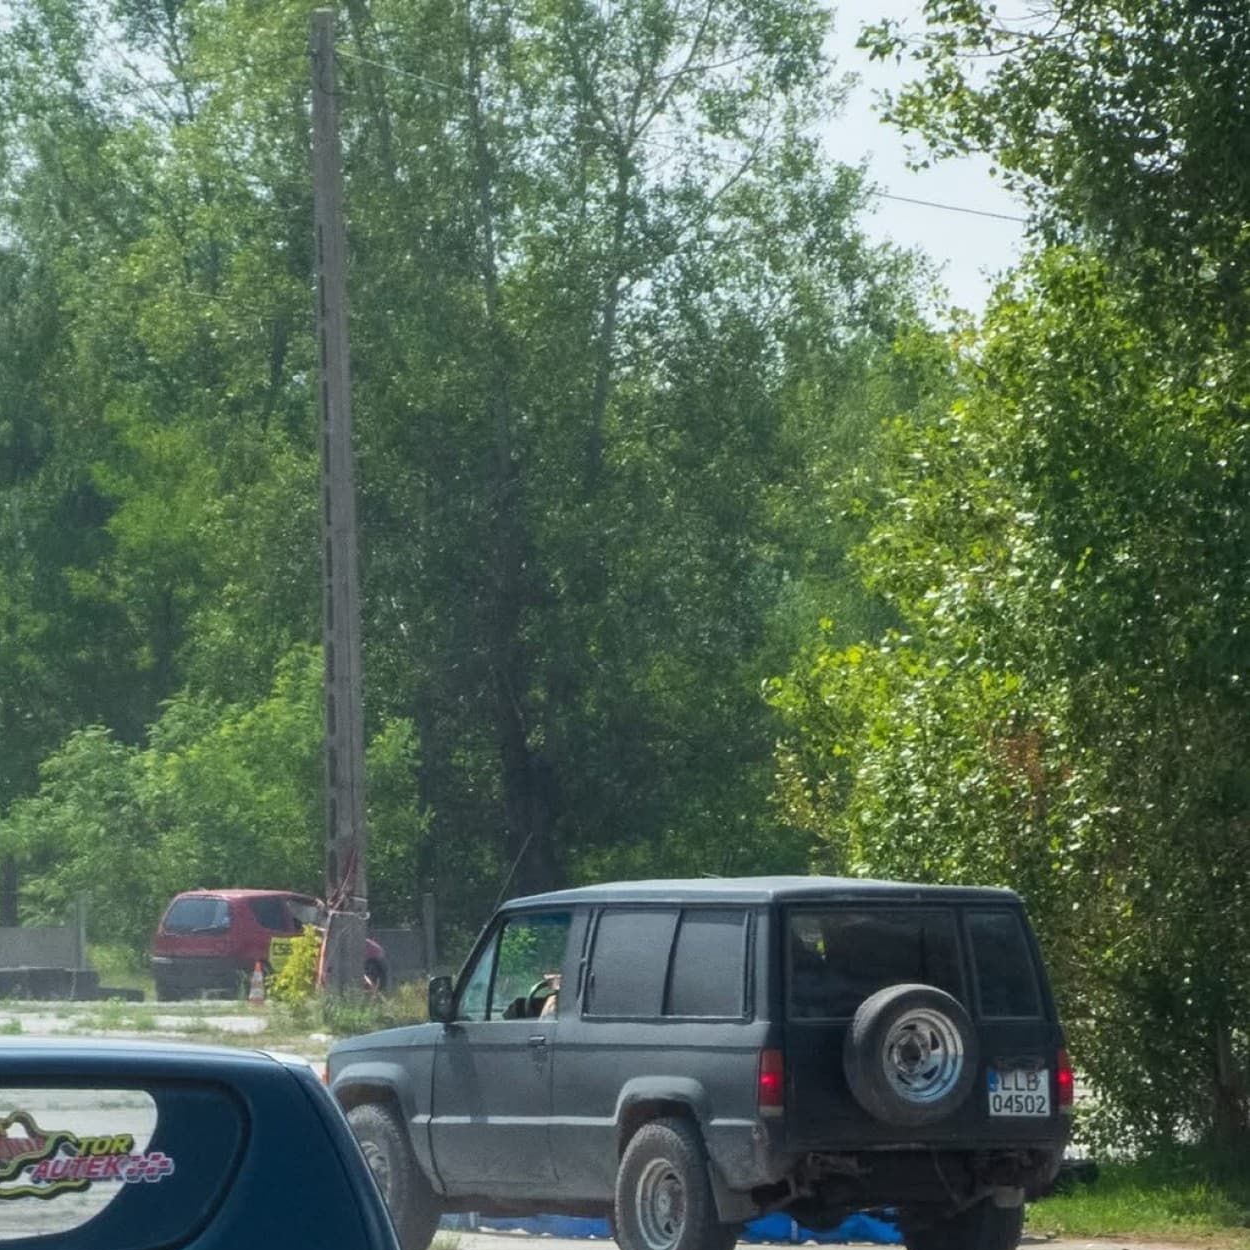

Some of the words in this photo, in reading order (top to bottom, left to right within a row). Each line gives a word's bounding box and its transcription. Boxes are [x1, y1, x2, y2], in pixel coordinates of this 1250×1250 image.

[993, 1094, 1047, 1113] 04502
[78, 1134, 133, 1154] TOR
[33, 1156, 122, 1178] AUTEK
